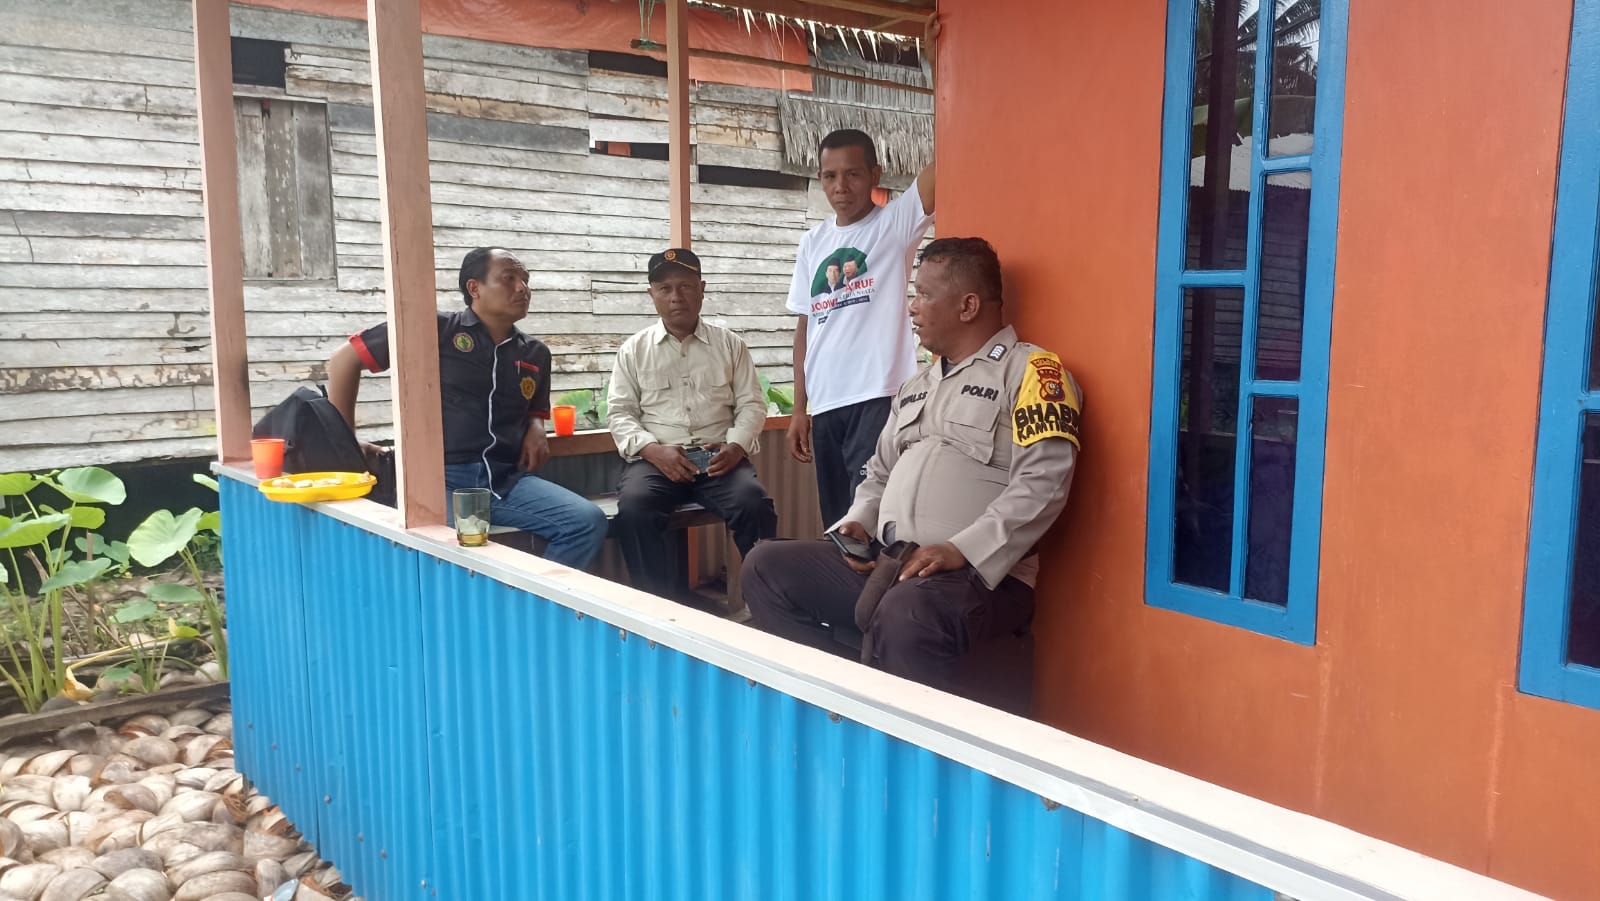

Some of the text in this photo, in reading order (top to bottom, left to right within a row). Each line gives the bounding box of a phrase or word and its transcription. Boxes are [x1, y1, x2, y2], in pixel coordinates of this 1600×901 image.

[845, 278, 874, 292] A'RUF
[961, 385, 999, 401] POLRI
[1015, 402, 1080, 429] BHAB
